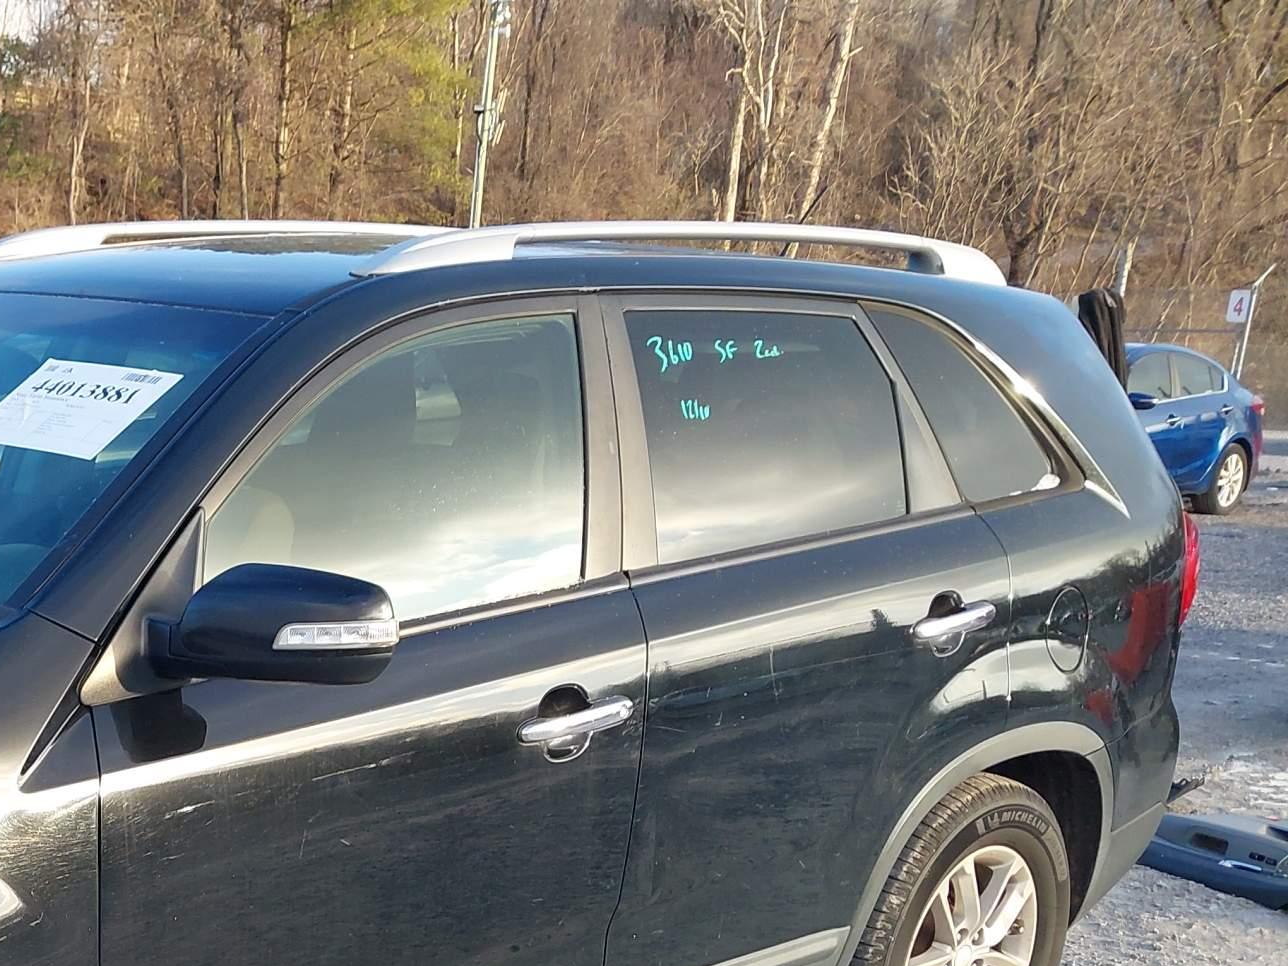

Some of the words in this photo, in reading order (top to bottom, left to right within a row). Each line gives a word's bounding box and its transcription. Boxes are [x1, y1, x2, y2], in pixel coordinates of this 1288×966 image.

[1233, 296, 1244, 316] 4
[31, 378, 140, 404] 44013881
[1000, 810, 1050, 834] MICHELIN
